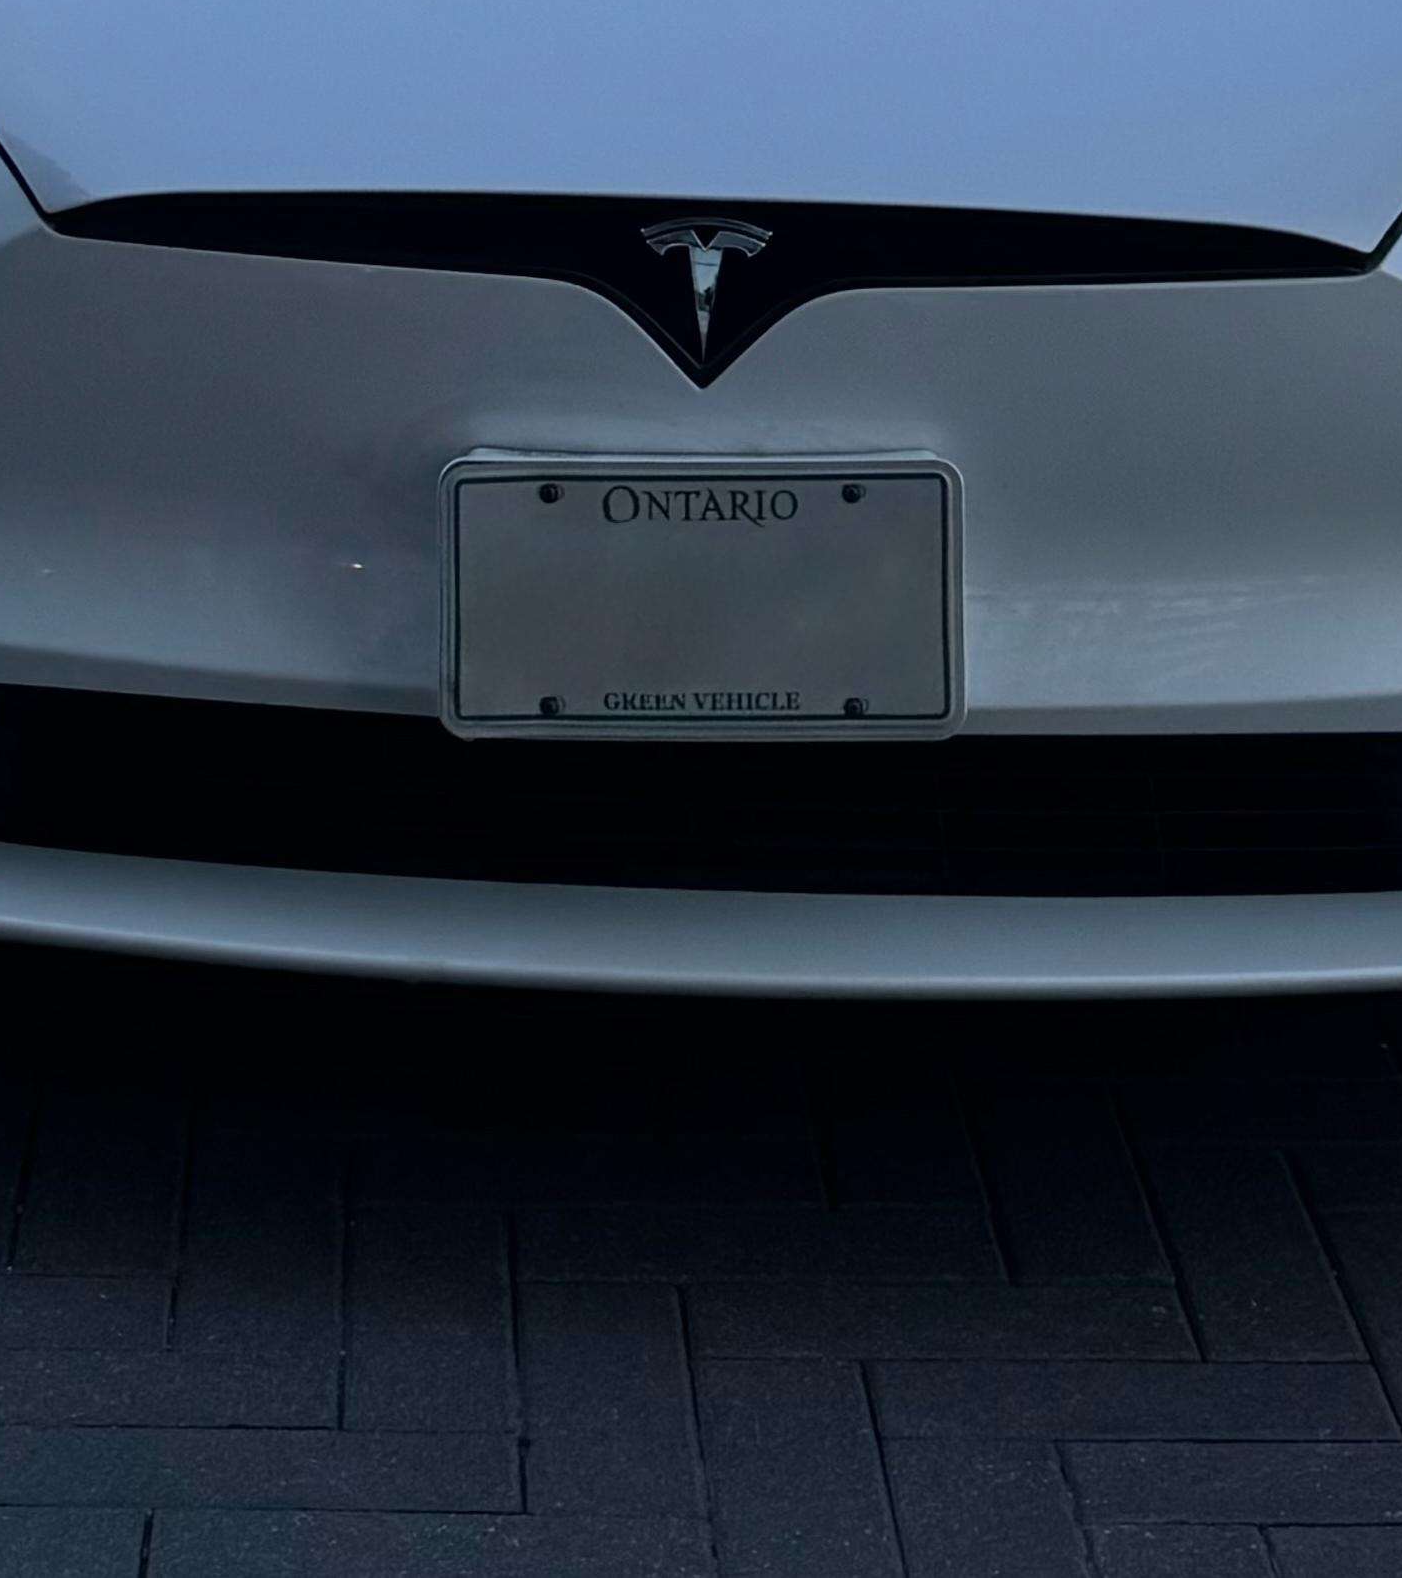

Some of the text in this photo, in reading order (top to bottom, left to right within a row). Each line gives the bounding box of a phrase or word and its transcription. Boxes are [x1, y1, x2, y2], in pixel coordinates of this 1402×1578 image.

[602, 484, 798, 528] ONTARIO
[603, 691, 801, 711] GREEN VEHICLE
